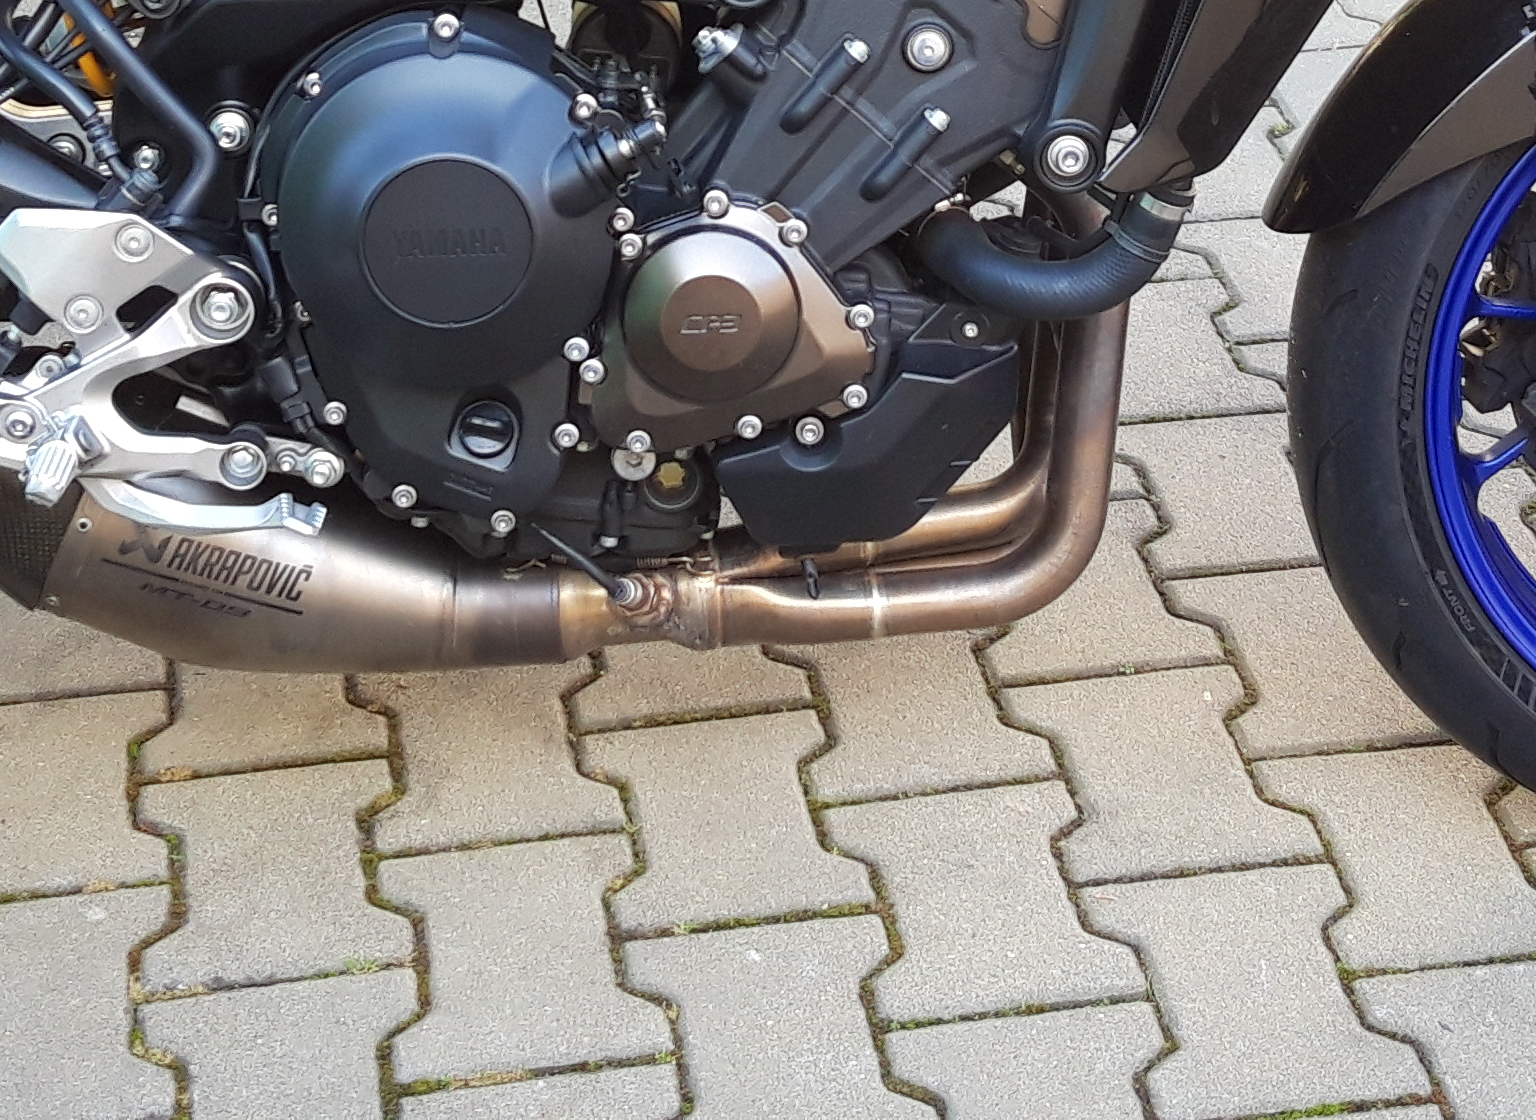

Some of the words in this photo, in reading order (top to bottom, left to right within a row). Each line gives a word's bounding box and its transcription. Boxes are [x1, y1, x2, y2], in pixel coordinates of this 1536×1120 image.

[392, 228, 507, 259] YAMAHA
[1399, 279, 1434, 411] MICHELIN
[139, 583, 253, 618] MT-09
[1444, 588, 1477, 632] FRONT
